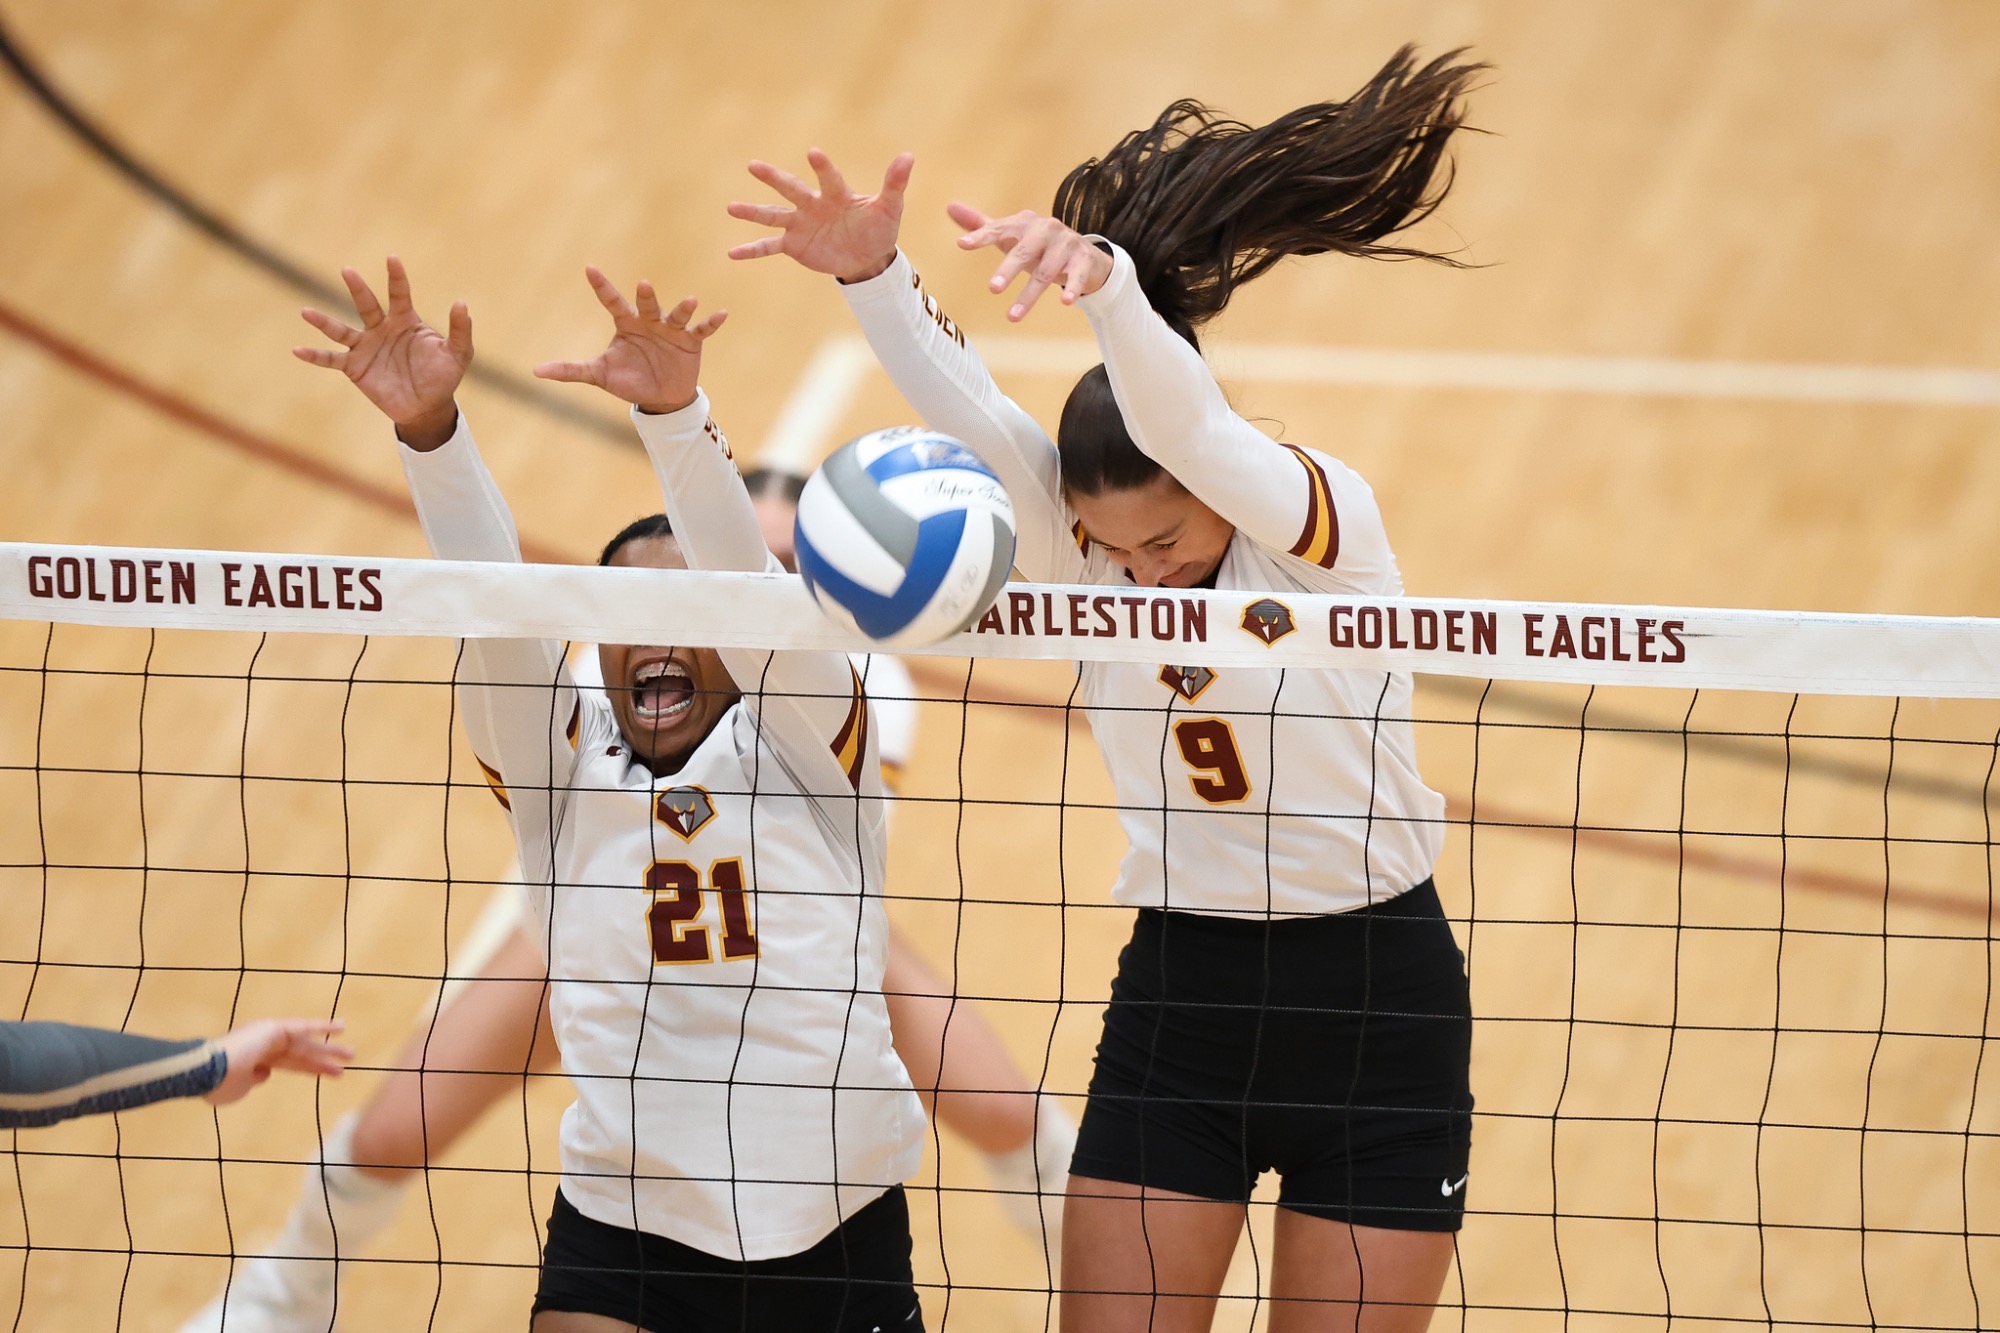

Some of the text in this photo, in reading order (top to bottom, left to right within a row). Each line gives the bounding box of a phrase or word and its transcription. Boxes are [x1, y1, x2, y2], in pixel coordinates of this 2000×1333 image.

[28, 555, 383, 612] GOLDEN EAGLES
[963, 592, 1207, 643] ARLESTON
[1329, 605, 1686, 664] GOLDEN EAGLES
[1171, 716, 1253, 806] 9
[642, 855, 762, 967] 21
